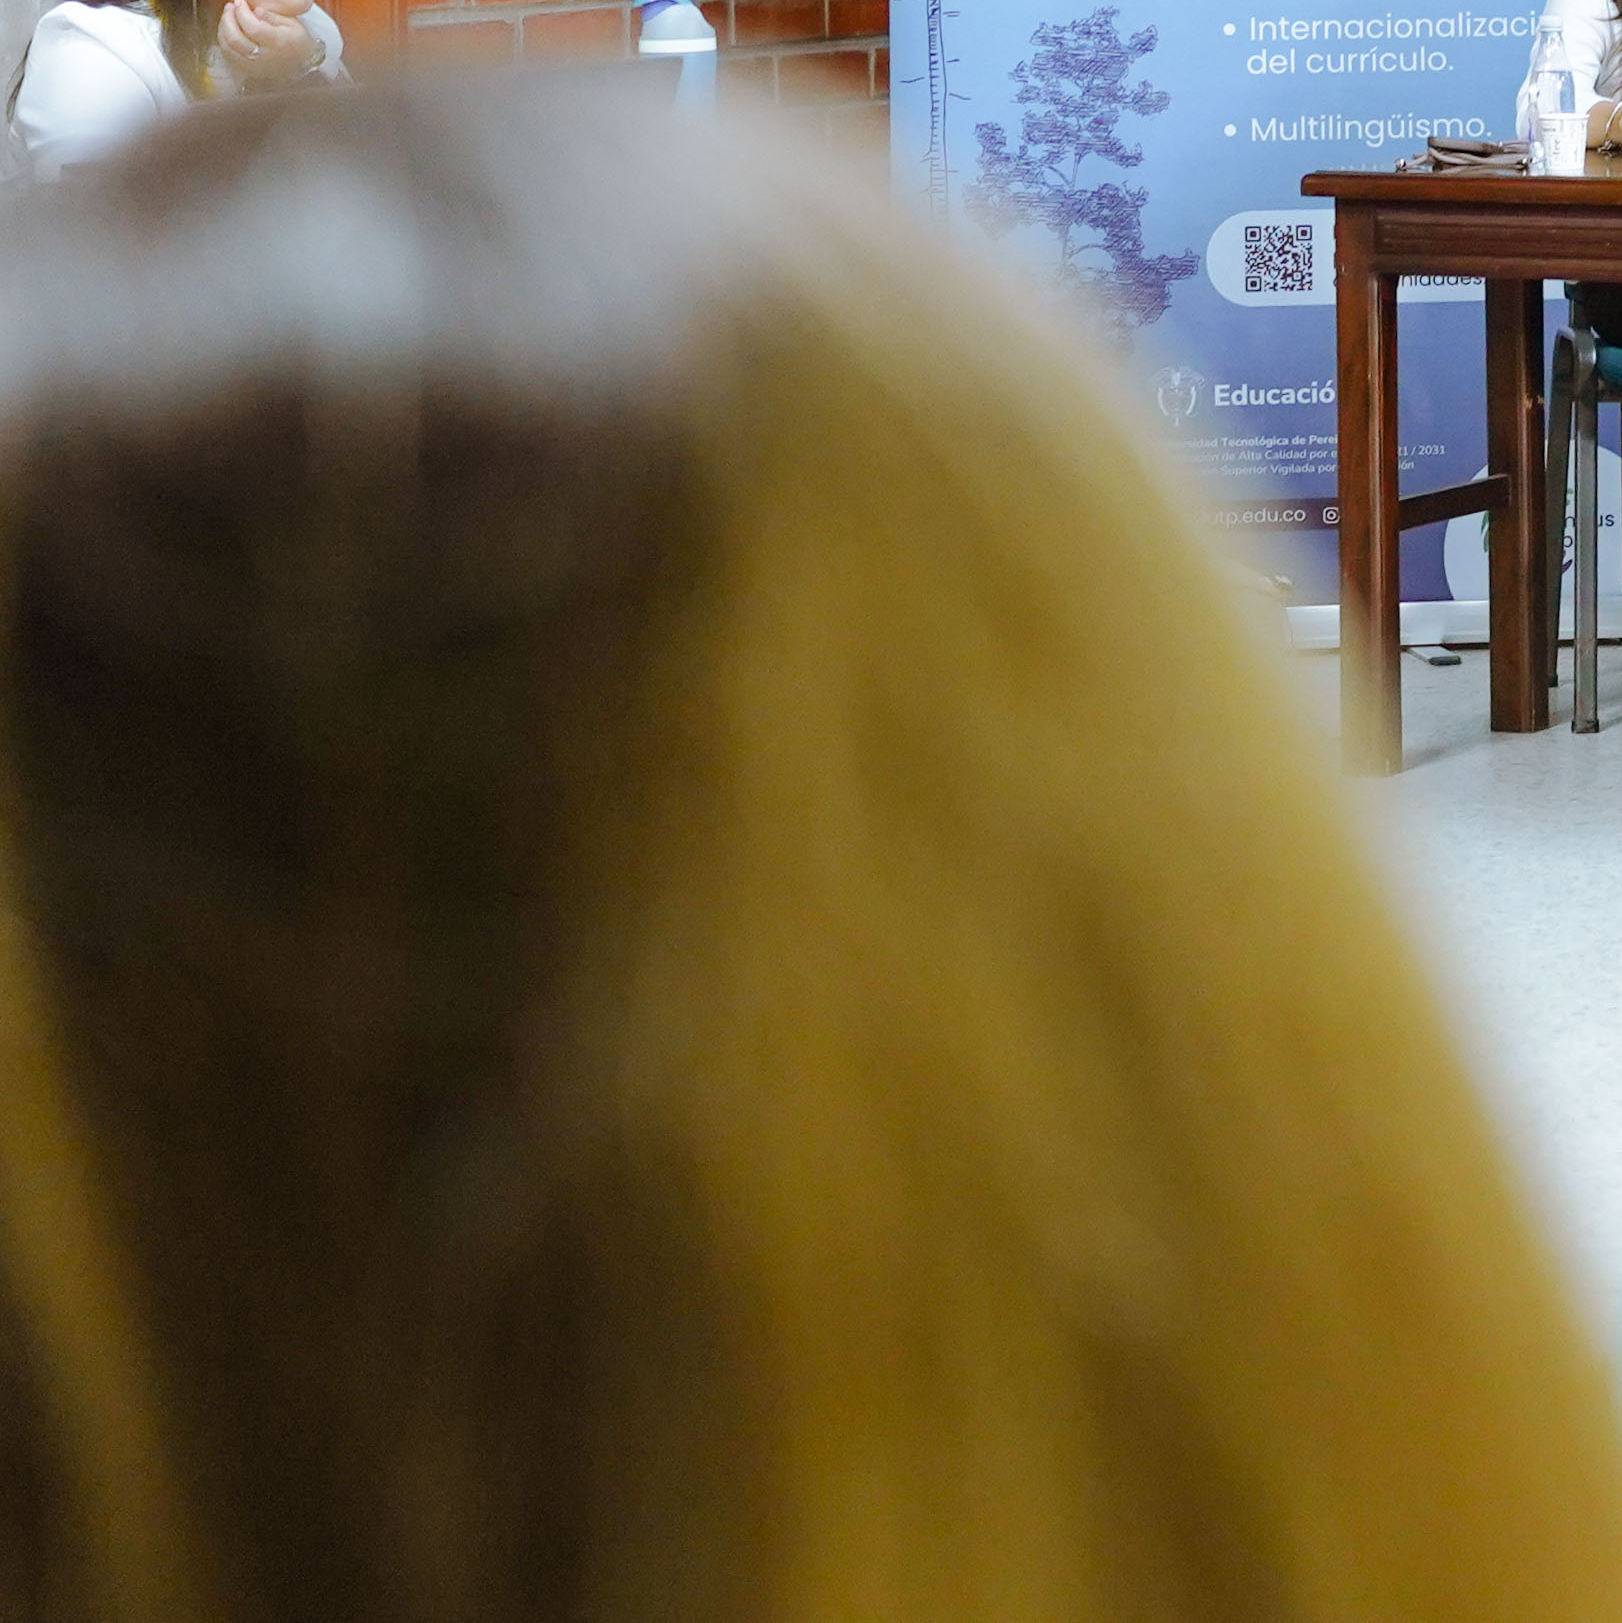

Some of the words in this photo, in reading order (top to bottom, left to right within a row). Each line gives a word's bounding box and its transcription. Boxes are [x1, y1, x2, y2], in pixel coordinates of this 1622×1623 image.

[1250, 11, 1537, 40] Internacionalizaci
[1246, 49, 1296, 75] del
[1305, 46, 1455, 75] currículo.
[1251, 112, 1493, 147] Multilingüismo.
[1213, 380, 1336, 407] Educació
[1264, 448, 1307, 460] Calidad
[1310, 450, 1328, 460] por
[1418, 444, 1446, 456] 2031
[1270, 464, 1315, 476] Vigilada
